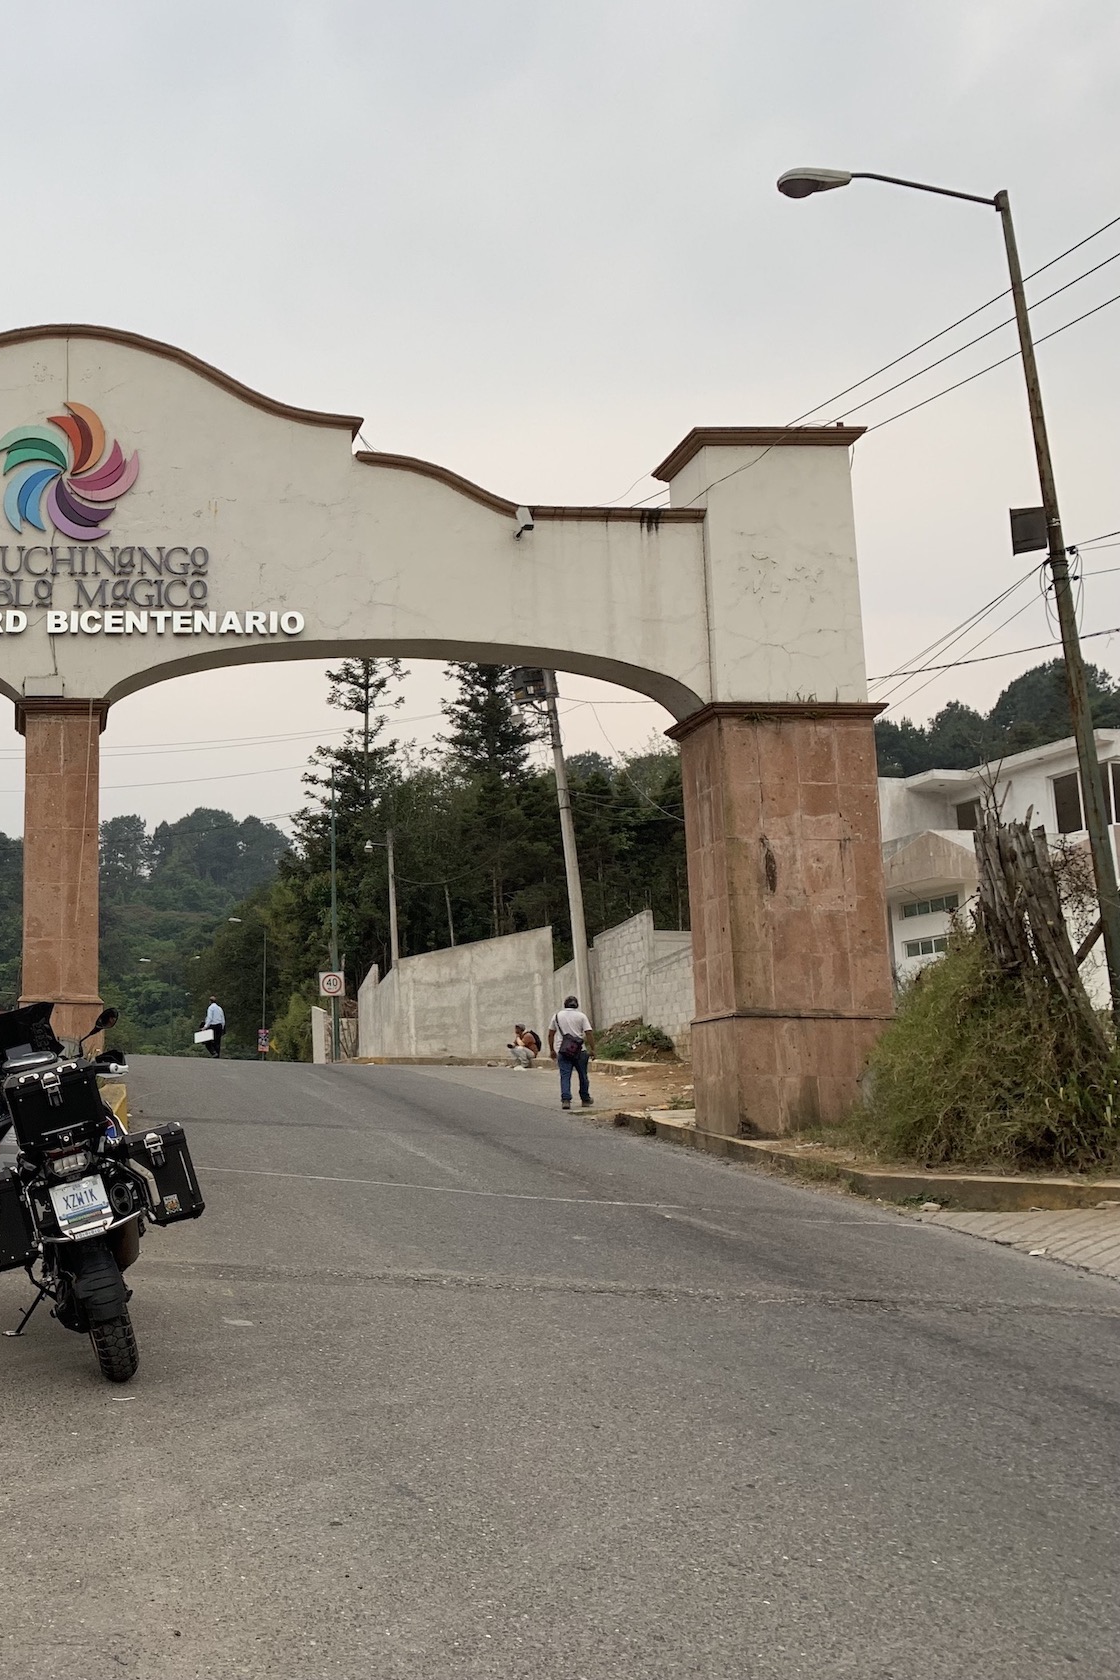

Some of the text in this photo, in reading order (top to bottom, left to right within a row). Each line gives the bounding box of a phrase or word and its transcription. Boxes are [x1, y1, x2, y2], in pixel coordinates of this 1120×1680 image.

[46, 610, 305, 635] BICENTENARIO
[326, 977, 338, 987] 40
[62, 1188, 98, 1210] XZW1K
